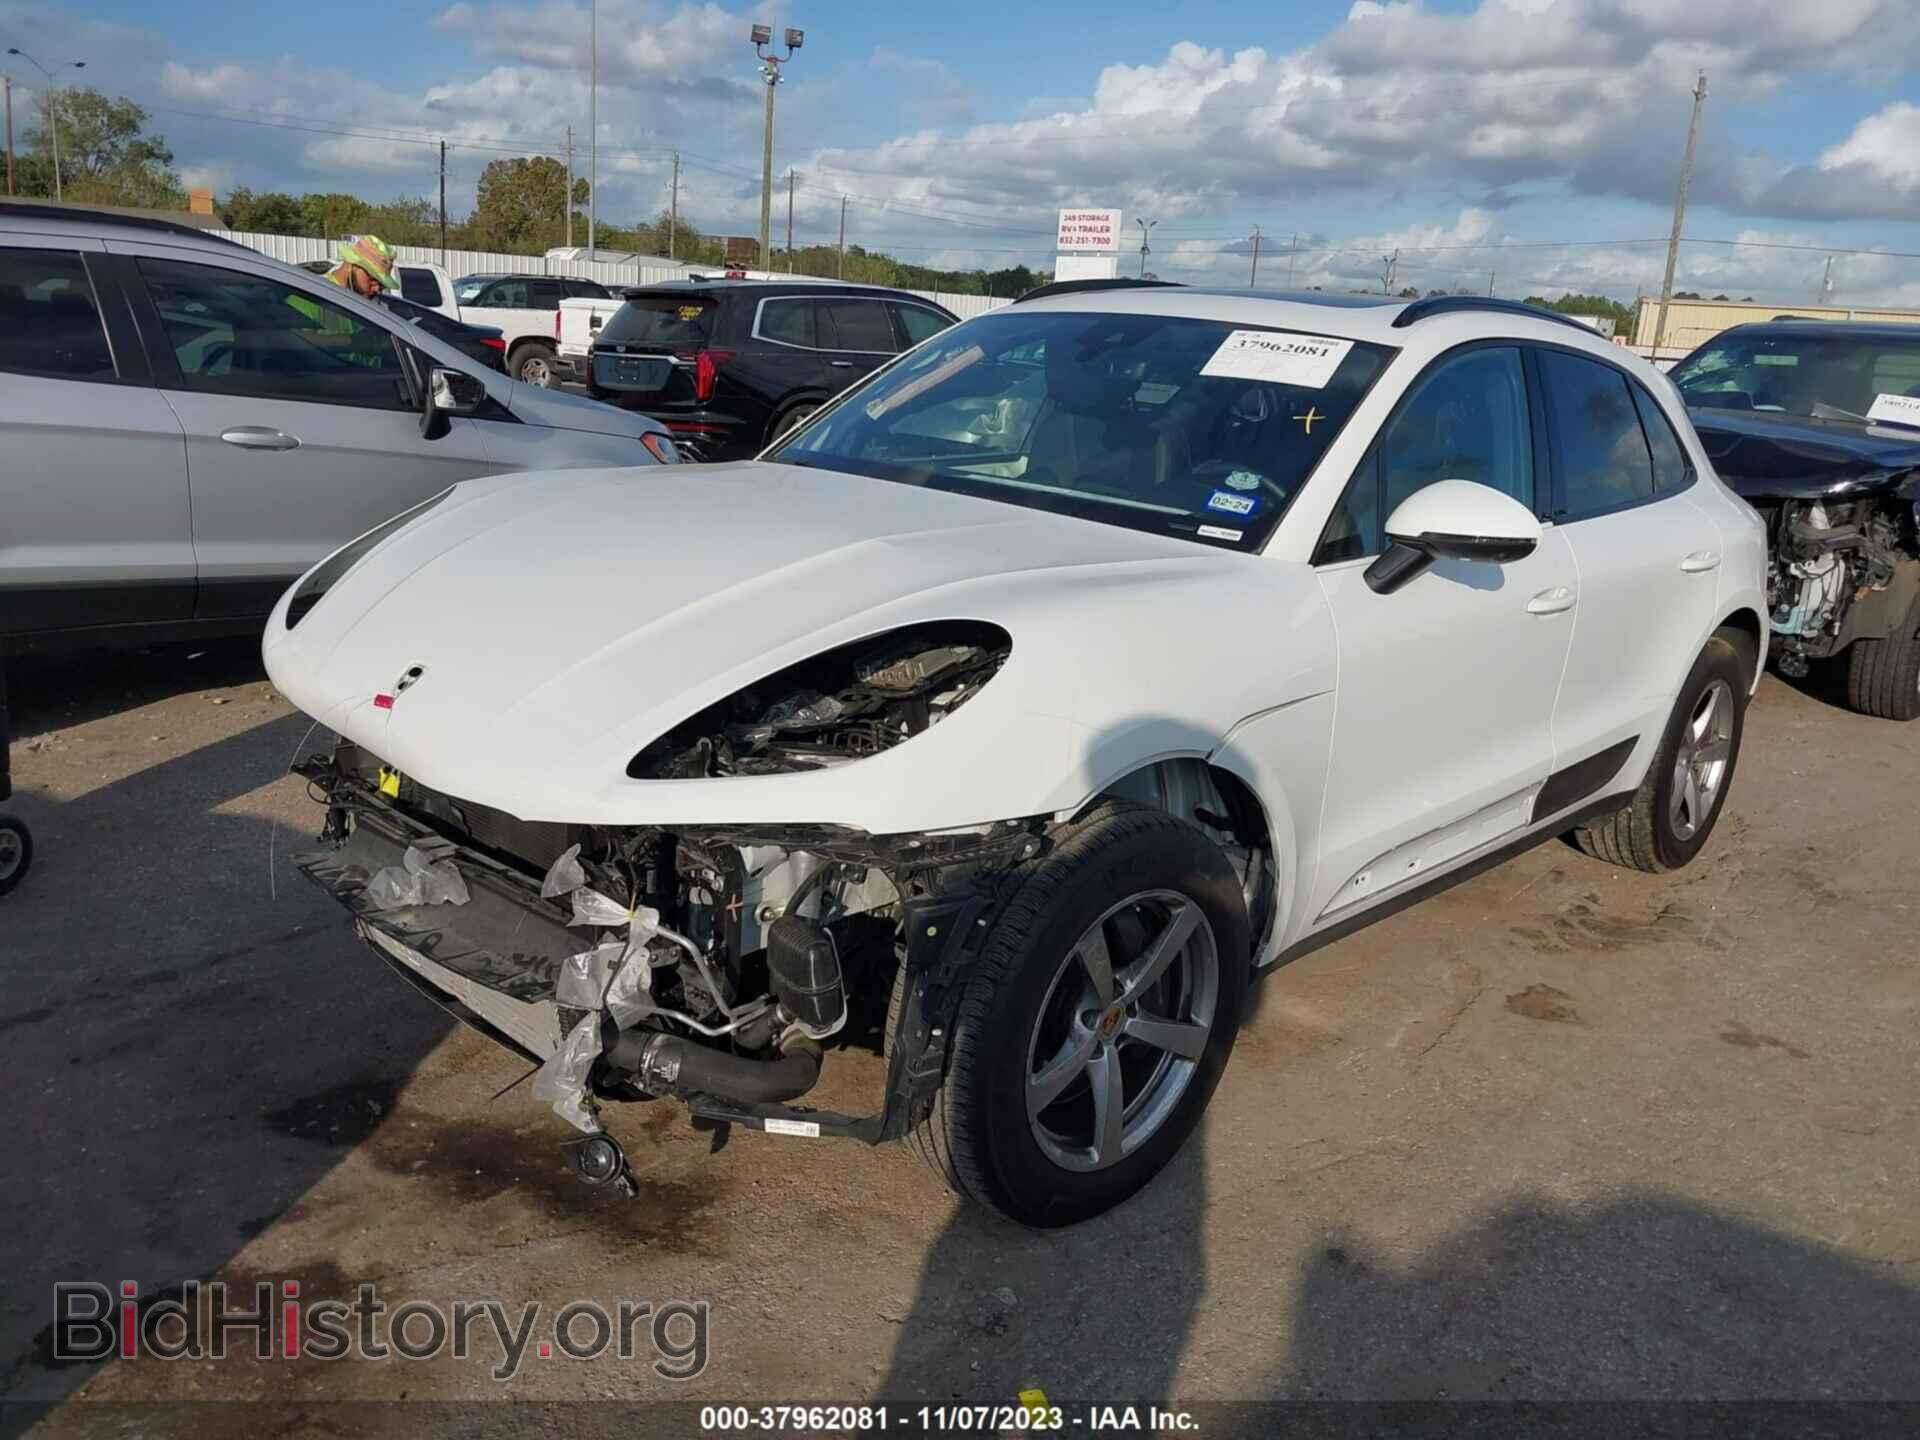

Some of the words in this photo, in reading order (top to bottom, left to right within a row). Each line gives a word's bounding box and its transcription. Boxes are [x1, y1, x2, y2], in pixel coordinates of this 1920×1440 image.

[1078, 214, 1110, 222] STORAGE
[1078, 225, 1111, 233] TRAILER
[1233, 339, 1329, 358] 37962081
